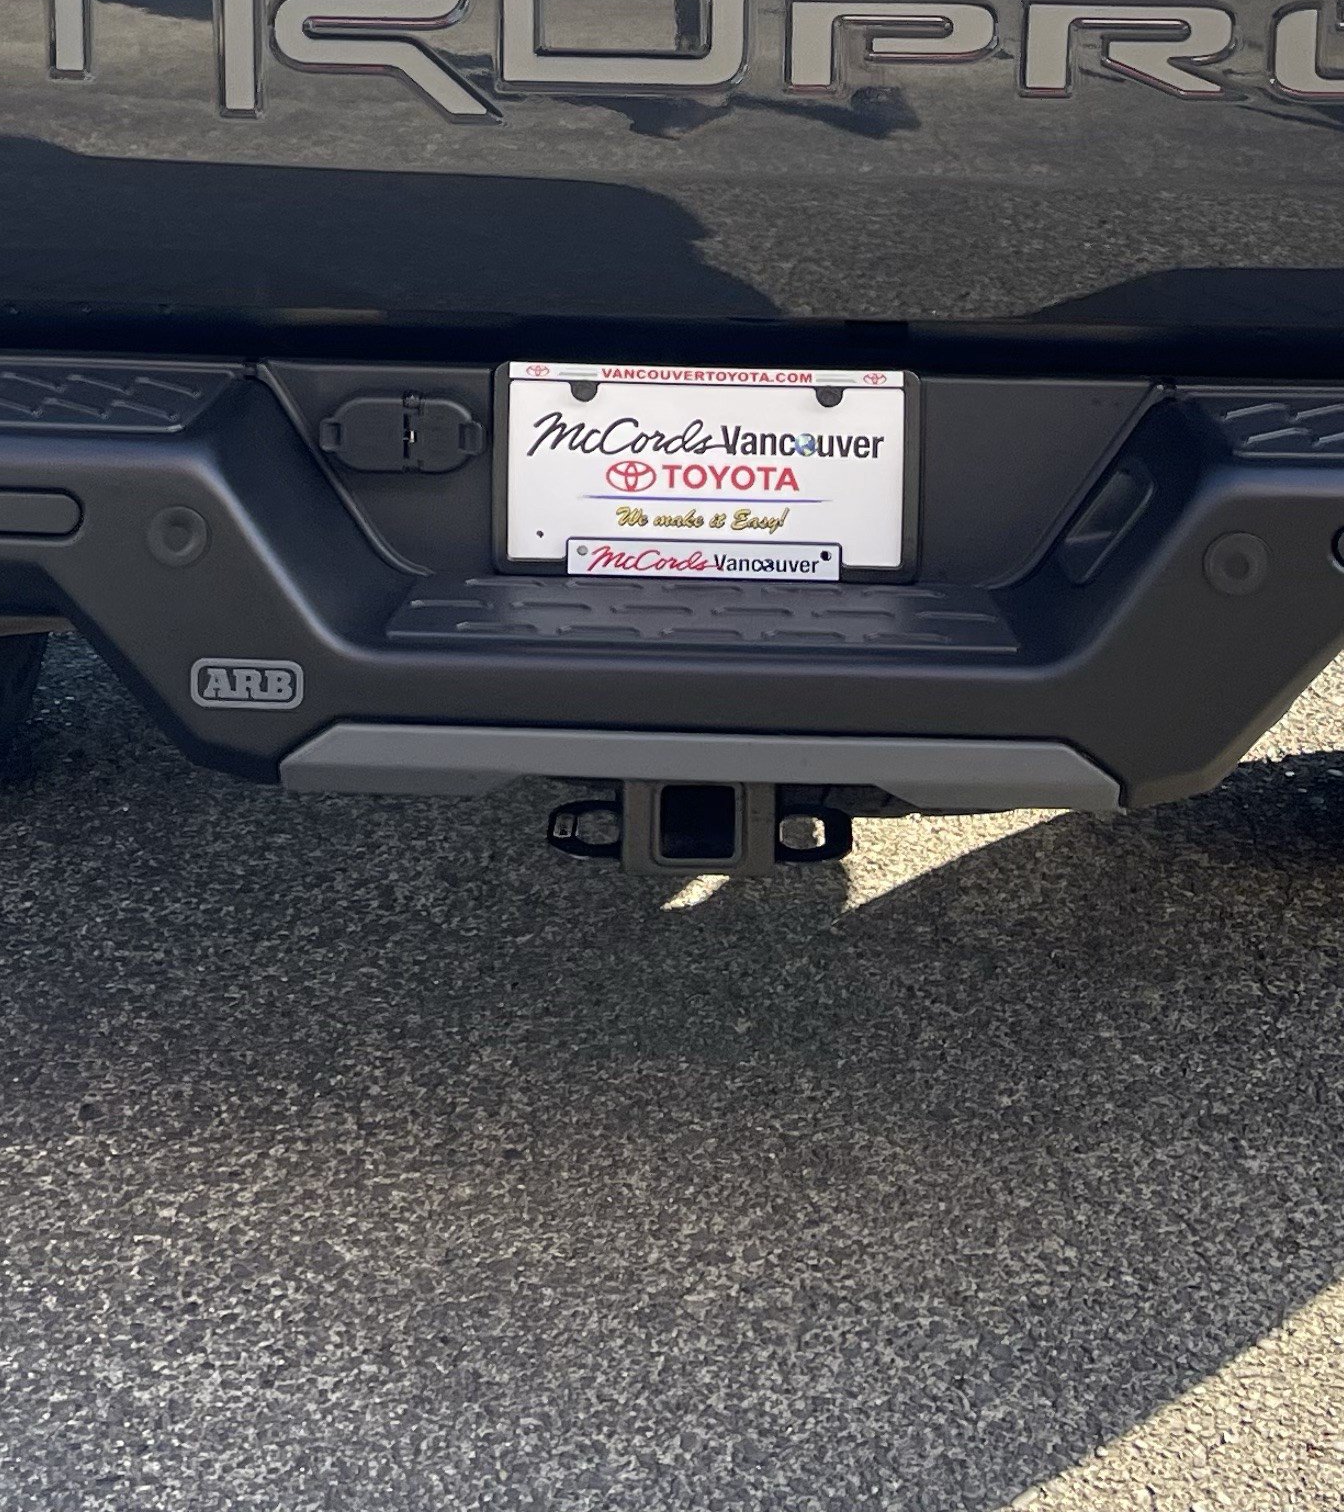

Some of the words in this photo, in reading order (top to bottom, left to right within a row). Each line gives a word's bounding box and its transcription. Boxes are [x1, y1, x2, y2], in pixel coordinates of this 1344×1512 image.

[601, 367, 813, 383] VANCOUVERTOYOTA.COM
[661, 463, 801, 492] TOYOTA
[615, 505, 649, 527] We
[652, 508, 705, 529] make
[708, 511, 727, 529] it
[729, 506, 791, 535] Easy!
[202, 667, 294, 701] ARB
